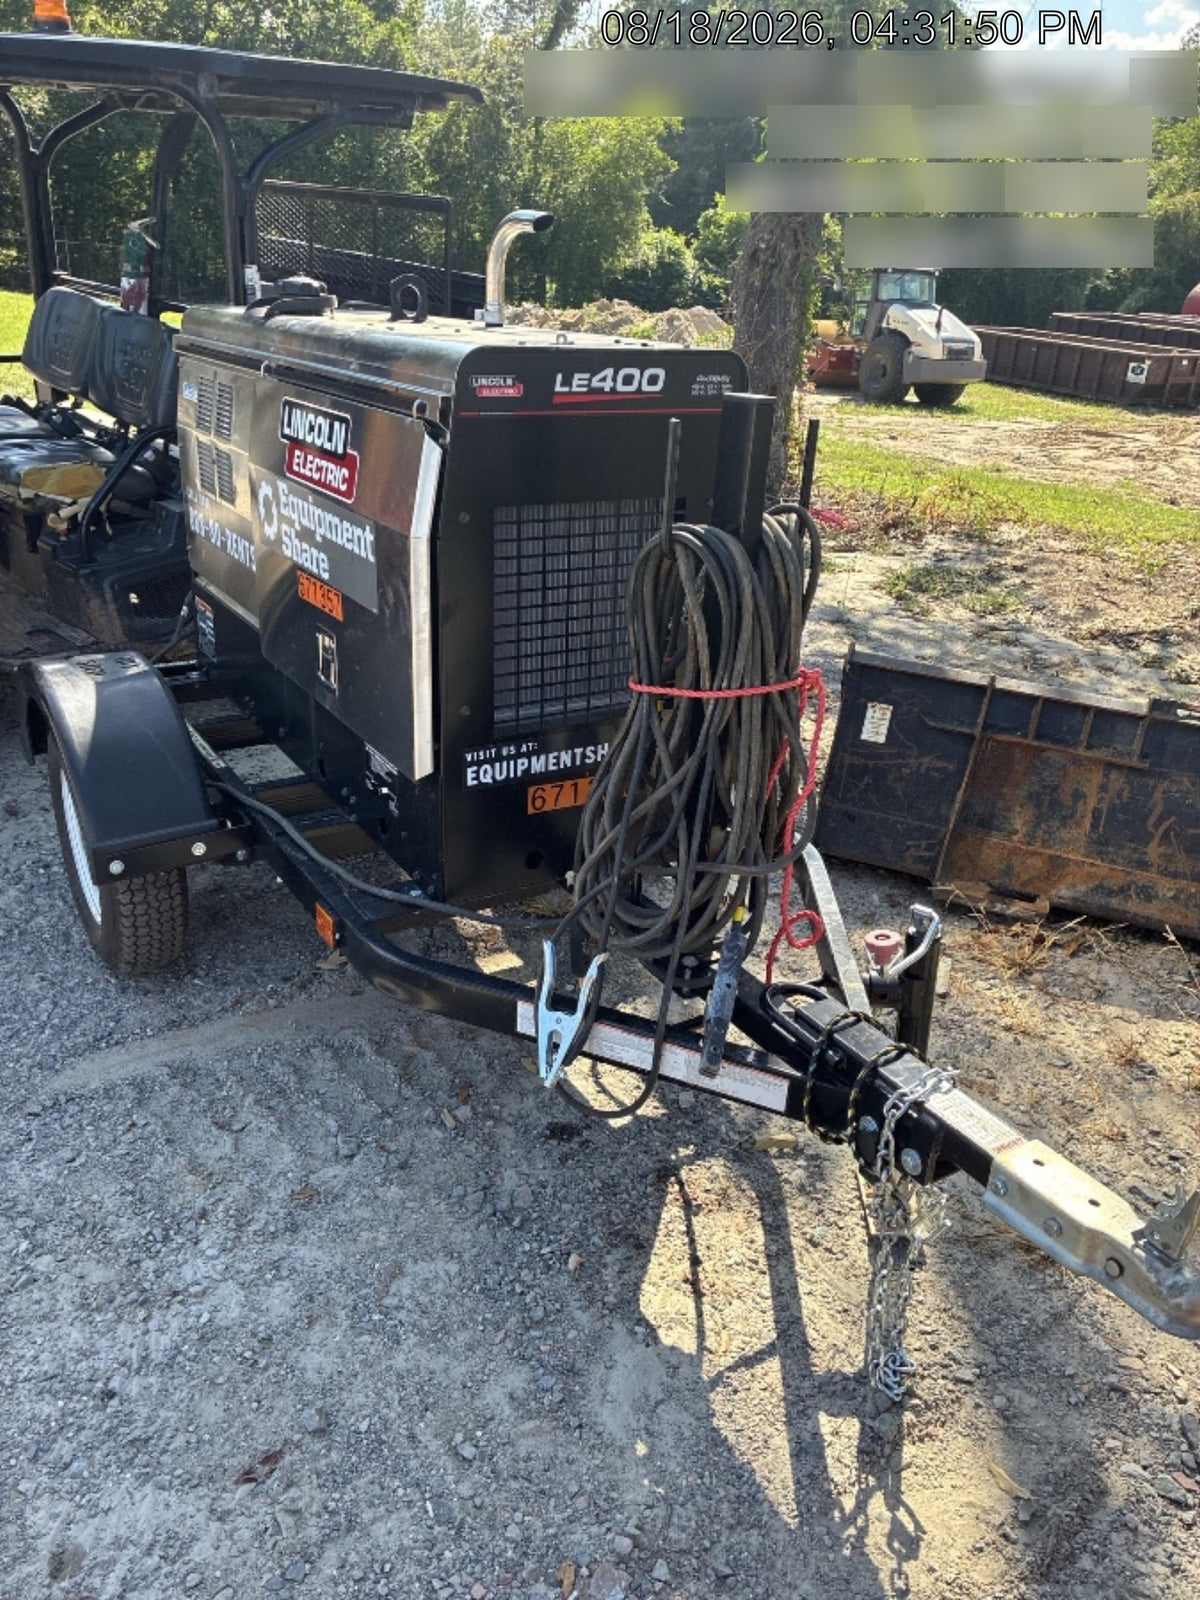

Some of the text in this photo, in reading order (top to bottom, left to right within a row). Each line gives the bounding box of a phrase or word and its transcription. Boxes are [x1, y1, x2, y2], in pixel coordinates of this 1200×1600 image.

[472, 377, 513, 387] LINCOLN
[554, 367, 666, 392] LE400
[283, 405, 346, 454] LINCOLN
[292, 449, 349, 492] ELECTRIC
[277, 480, 375, 563] Equipment
[281, 522, 330, 580] Share
[465, 742, 538, 762] VISIT US AT:
[532, 779, 593, 812] 671
